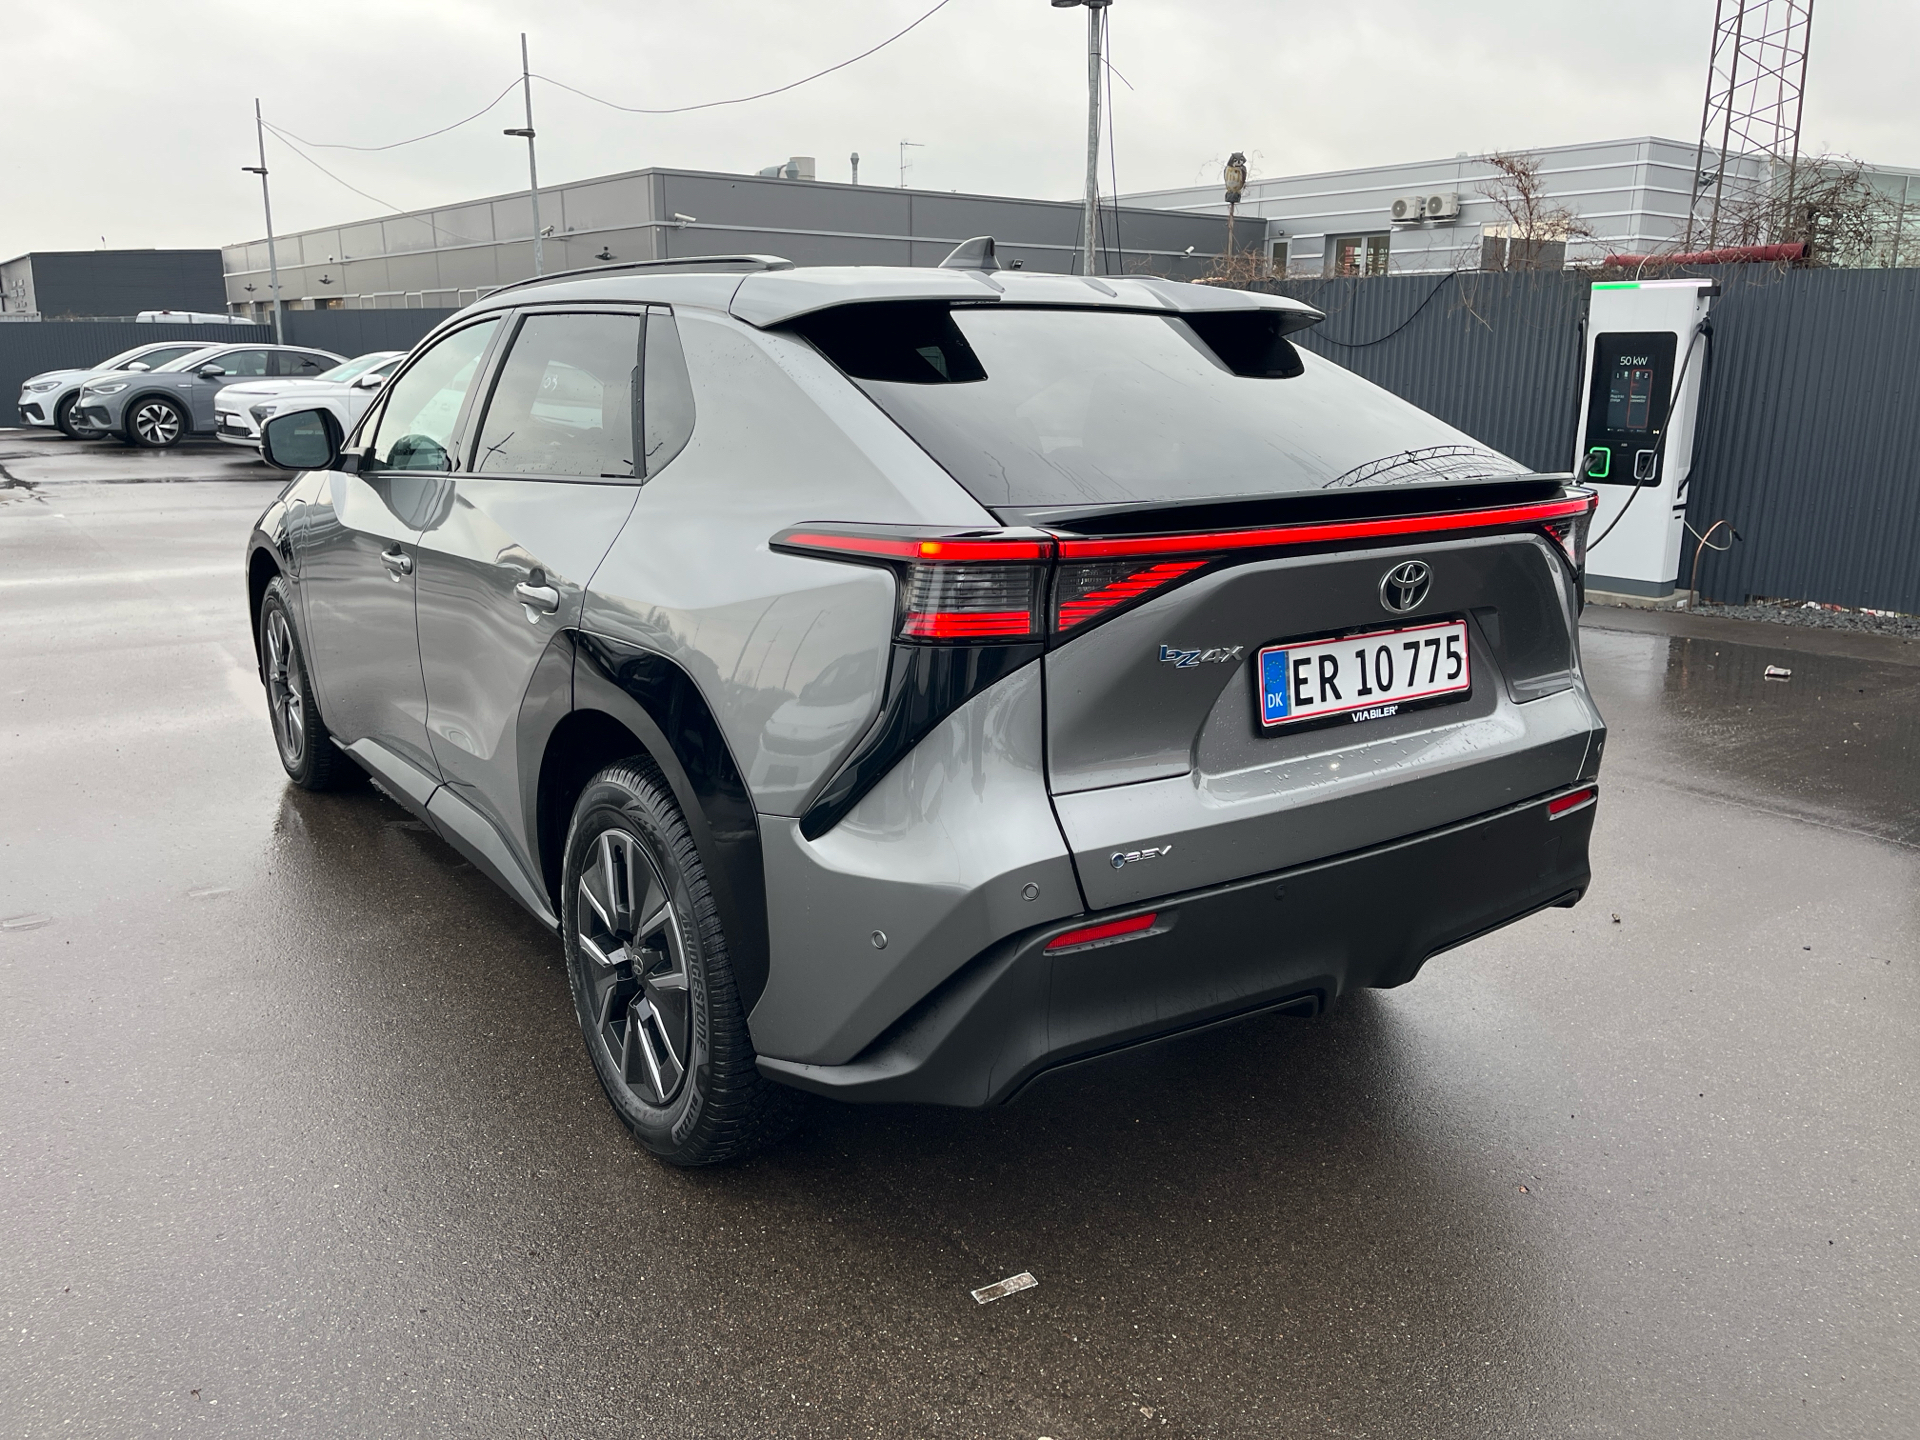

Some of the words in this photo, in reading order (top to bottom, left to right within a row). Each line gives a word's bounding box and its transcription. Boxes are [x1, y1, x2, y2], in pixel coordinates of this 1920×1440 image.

[1620, 356, 1632, 365] 50
[1633, 356, 1648, 365] kW
[1293, 654, 1343, 707] ER
[1355, 645, 1394, 697] 10
[1403, 634, 1462, 688] 775
[1267, 692, 1283, 708] DK
[680, 911, 707, 1051] BRIDGESTONE
